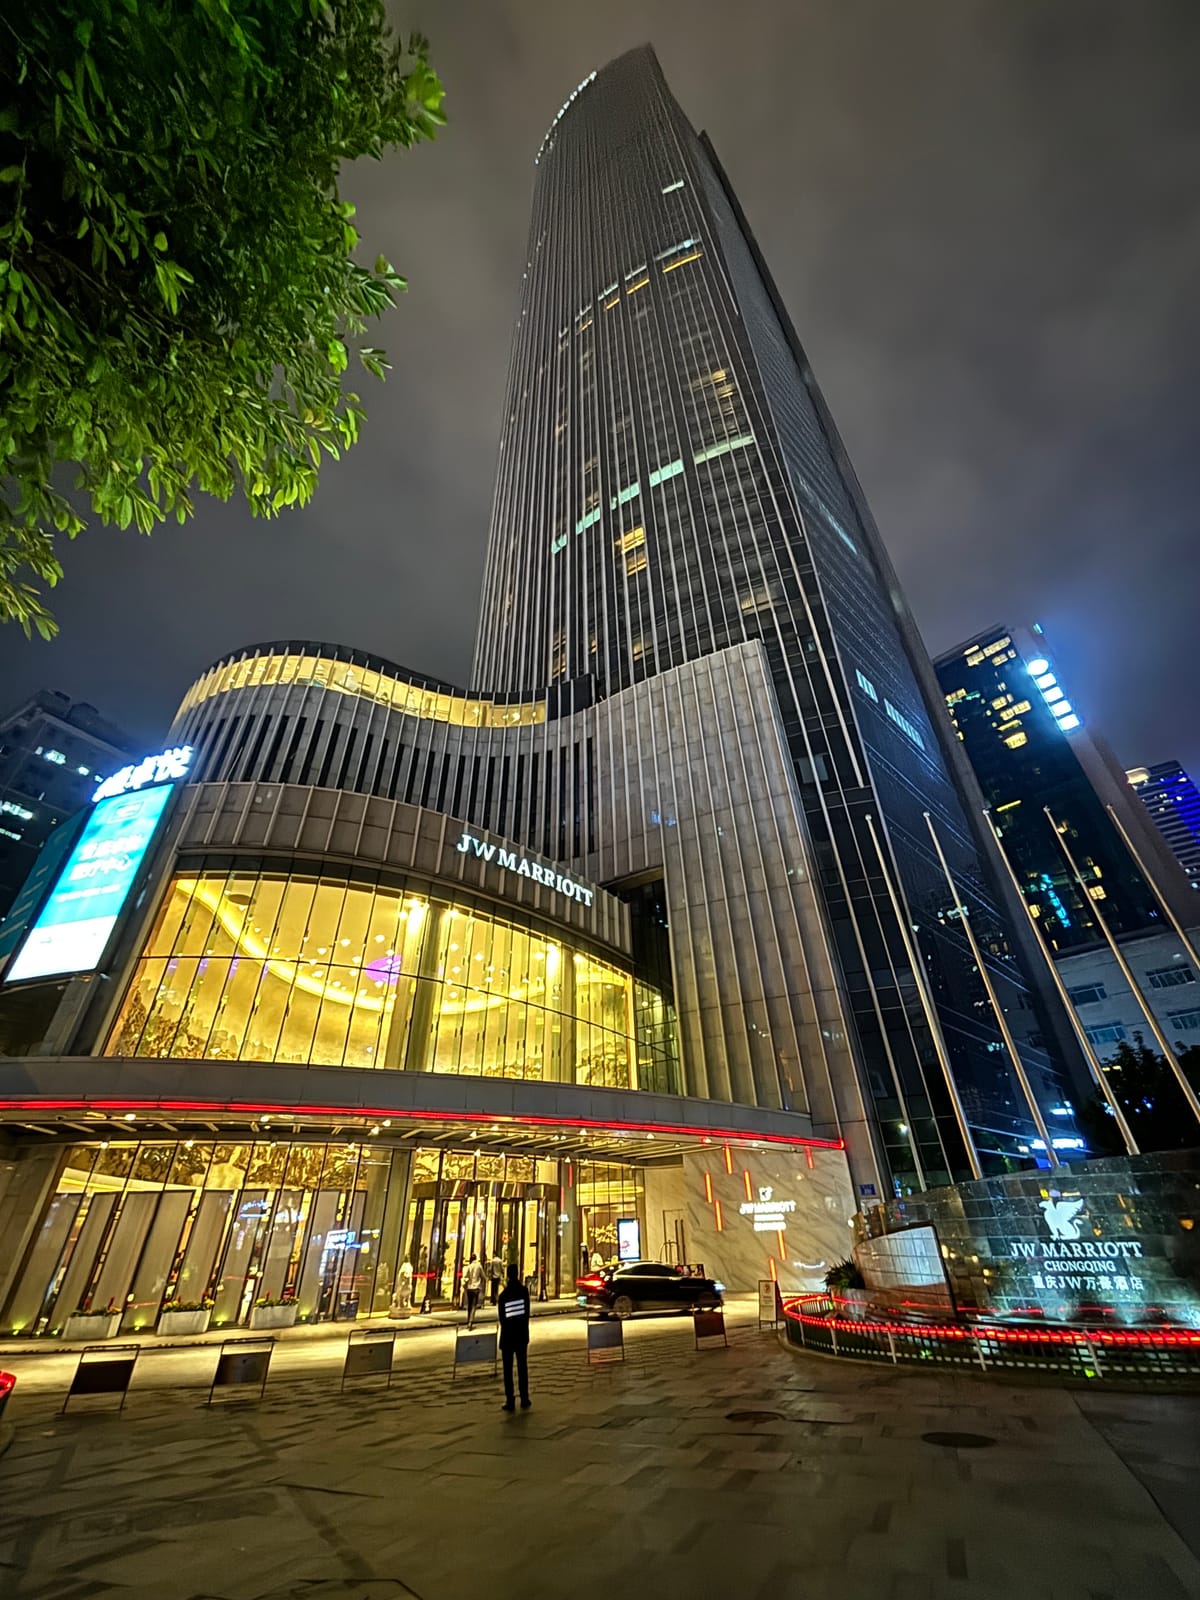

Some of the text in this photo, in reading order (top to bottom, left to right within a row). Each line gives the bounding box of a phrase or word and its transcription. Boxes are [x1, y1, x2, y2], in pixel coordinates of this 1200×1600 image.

[457, 833, 593, 907] JW MARRIOTT
[1010, 1241, 1143, 1258] JW MARRIOTT
[1043, 1260, 1116, 1273] CHONGQING
